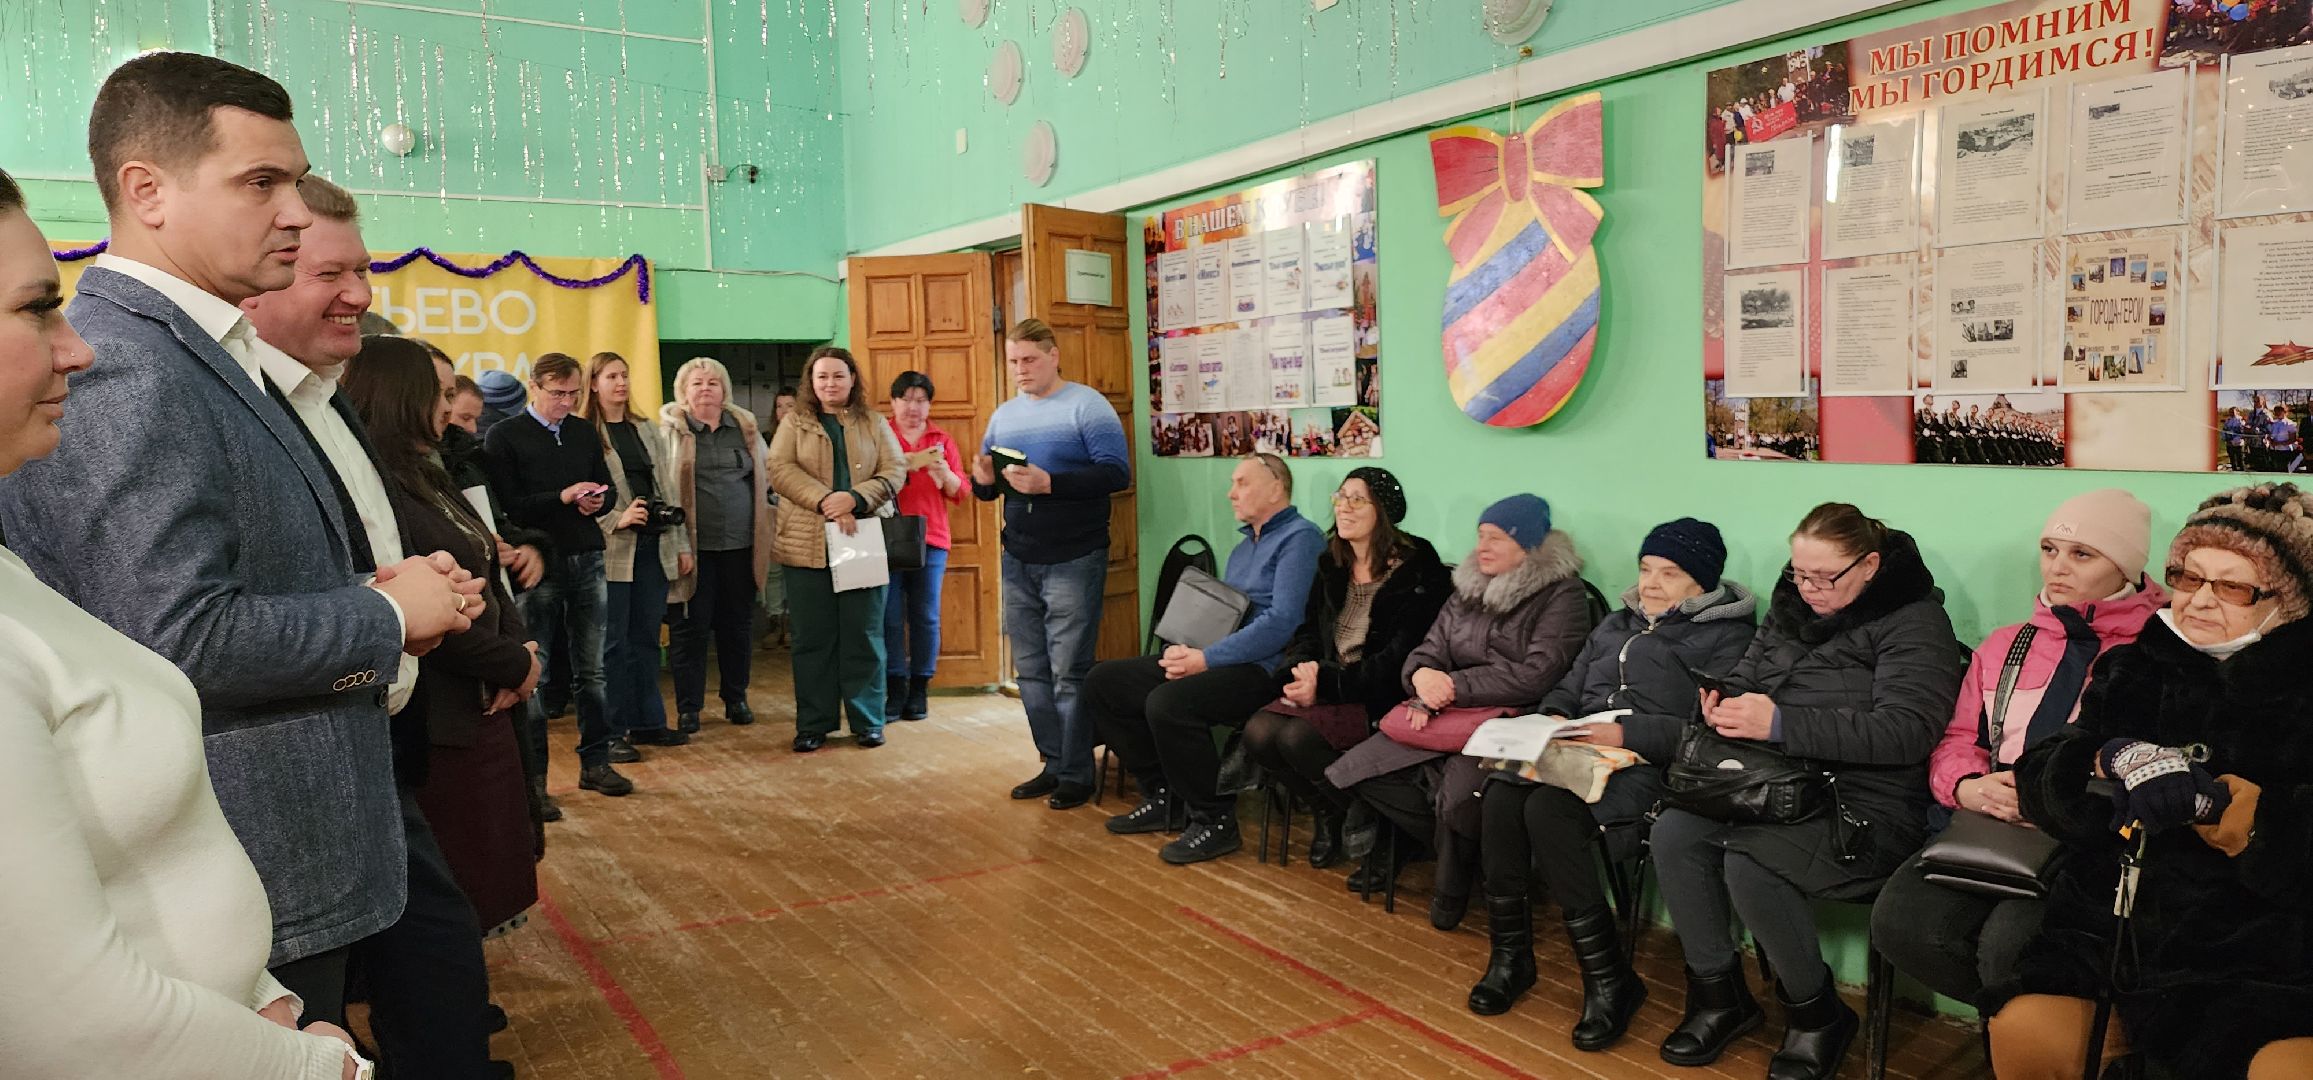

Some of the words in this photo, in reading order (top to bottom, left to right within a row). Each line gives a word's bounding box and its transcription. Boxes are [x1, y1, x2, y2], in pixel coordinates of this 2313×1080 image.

[1849, 76, 1910, 112] МЫ
[1922, 27, 2155, 100] ГОРДИМСЯ!
[1870, 37, 1932, 76] МЫ
[1944, 0, 2132, 60] ПОМНИМ
[1174, 217, 1185, 240] В
[1188, 203, 1251, 237] НАШЕМ
